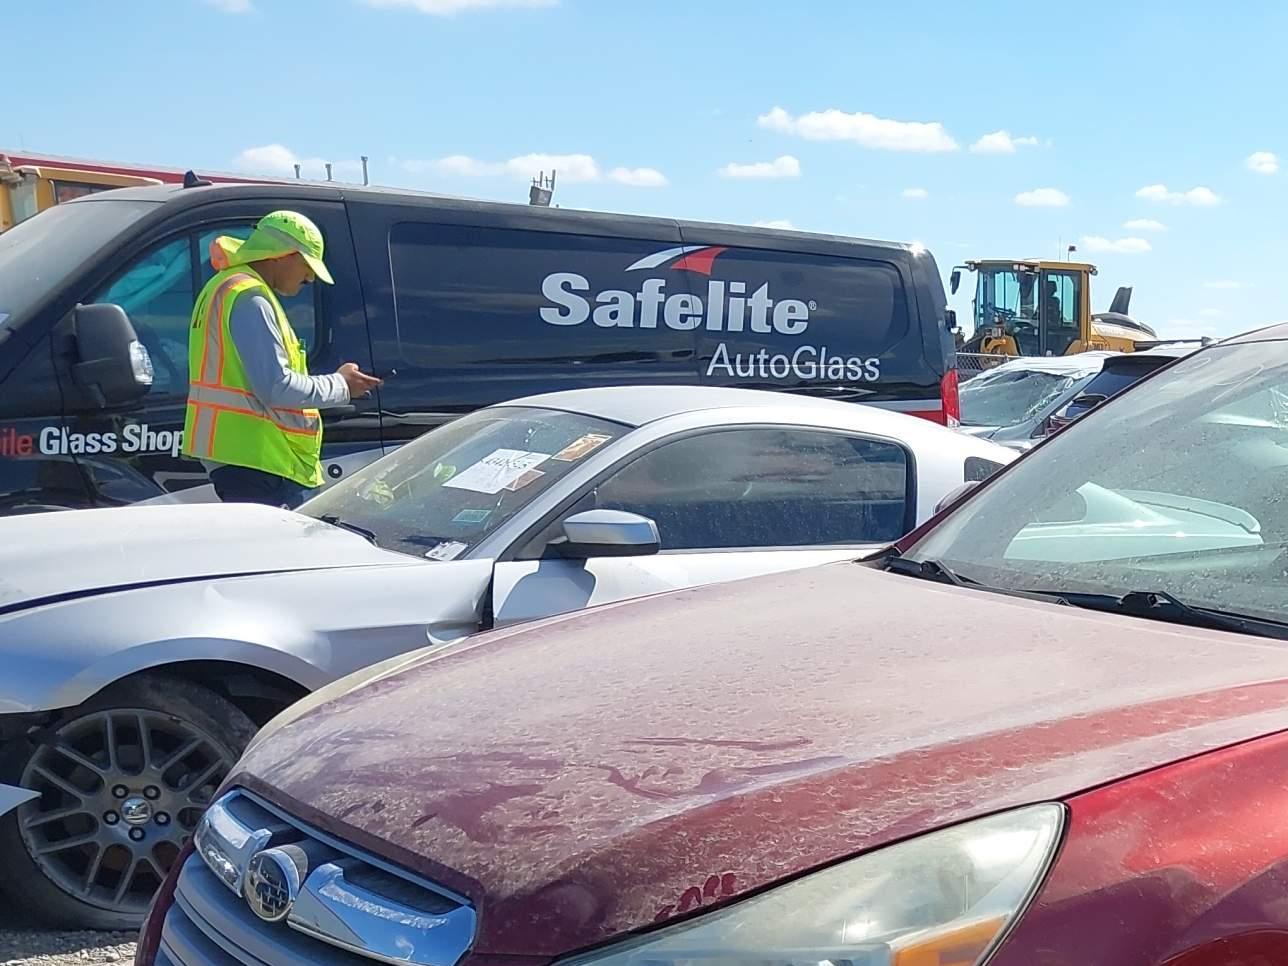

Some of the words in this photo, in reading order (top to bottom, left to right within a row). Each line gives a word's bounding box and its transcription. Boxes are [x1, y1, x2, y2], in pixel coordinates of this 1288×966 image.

[706, 343, 880, 381] AutoGlass
[0, 427, 33, 456] ile
[40, 426, 117, 455] Glass
[122, 424, 185, 457] Shop
